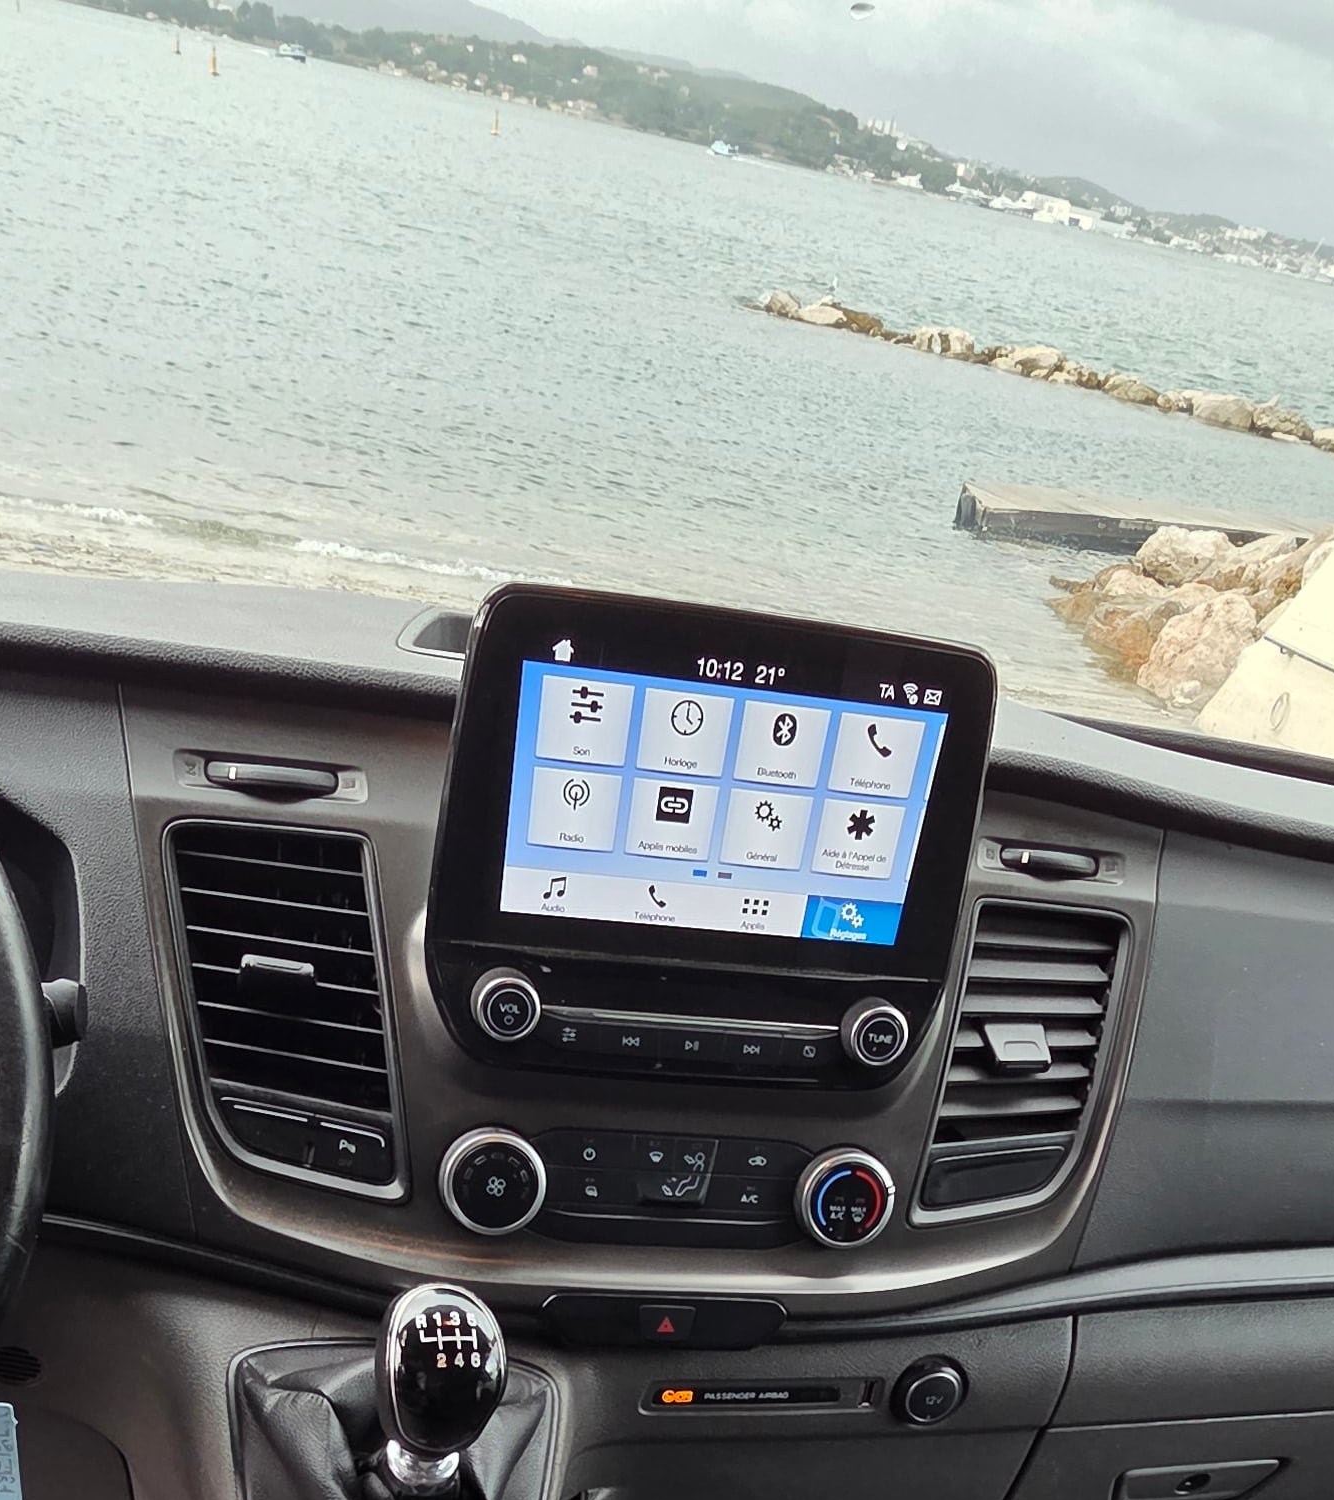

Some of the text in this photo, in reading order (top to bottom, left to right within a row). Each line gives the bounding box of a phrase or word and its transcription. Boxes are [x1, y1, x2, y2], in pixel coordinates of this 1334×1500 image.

[697, 657, 786, 685] 10:12 21°
[879, 683, 895, 700] TA
[573, 746, 590, 757] Son
[664, 756, 697, 769] Horloge
[757, 767, 796, 780] Bluetooth
[850, 777, 891, 791] Téléphone
[559, 832, 584, 843] Radio
[638, 840, 697, 854] Applis mobiles
[746, 851, 778, 863] Général
[822, 848, 840, 859] Aide
[876, 855, 887, 863] de
[541, 903, 565, 913] Audio
[634, 911, 675, 923] Téléphone
[740, 921, 765, 931] Applis
[499, 1003, 521, 1014] VOL
[868, 1033, 893, 1044] TUNE
[740, 1194, 759, 1203] A/C
[415, 1311, 477, 1329] R 1 3 5
[436, 1351, 481, 1368] 2 4 6
[704, 1391, 789, 1400] PASSENGER AIRBAG
